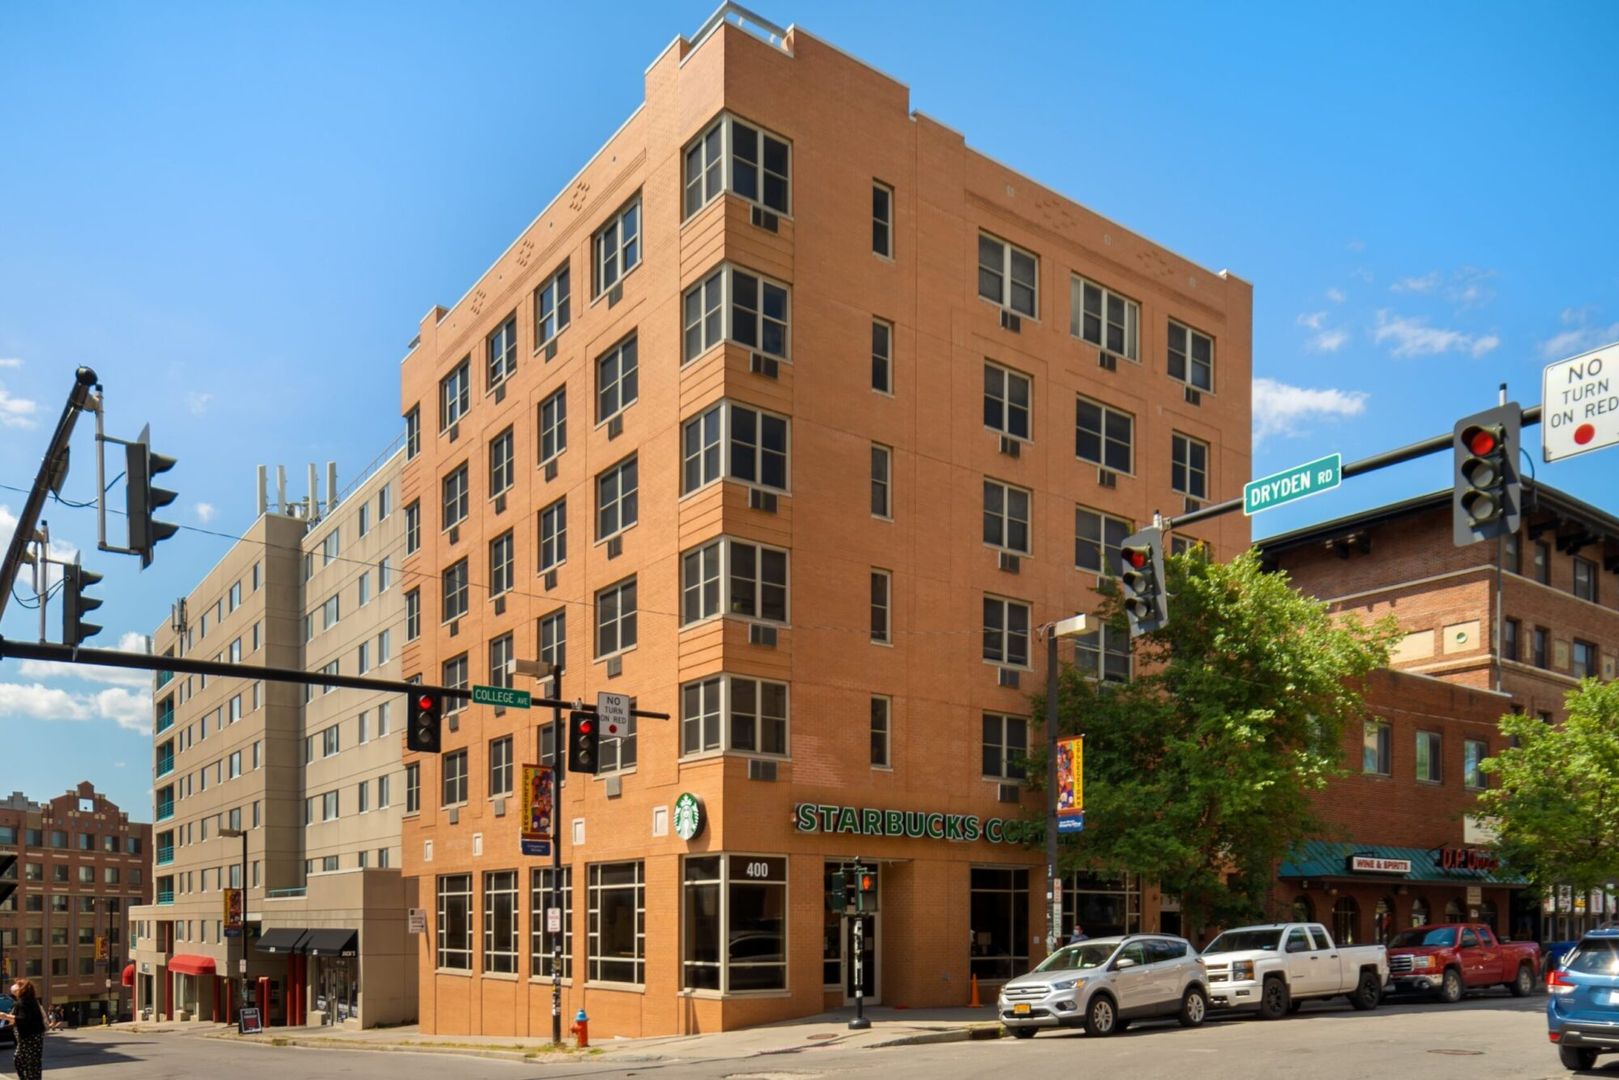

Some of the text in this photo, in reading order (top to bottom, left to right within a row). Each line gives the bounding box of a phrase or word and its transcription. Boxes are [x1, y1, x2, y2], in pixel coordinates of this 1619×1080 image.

[1568, 358, 1603, 384] NO
[1562, 378, 1609, 405] TURN
[1551, 396, 1619, 429] ON RED
[1250, 469, 1333, 507] DRYDEN RD
[475, 689, 528, 706] COLLEGE AVE
[606, 696, 621, 706] NO
[600, 714, 627, 724] ON RED
[604, 706, 623, 715] TURN
[798, 802, 981, 842] STARBUCKS
[746, 862, 769, 878] 400
[1357, 859, 1409, 870] WINE & SPIRITS
